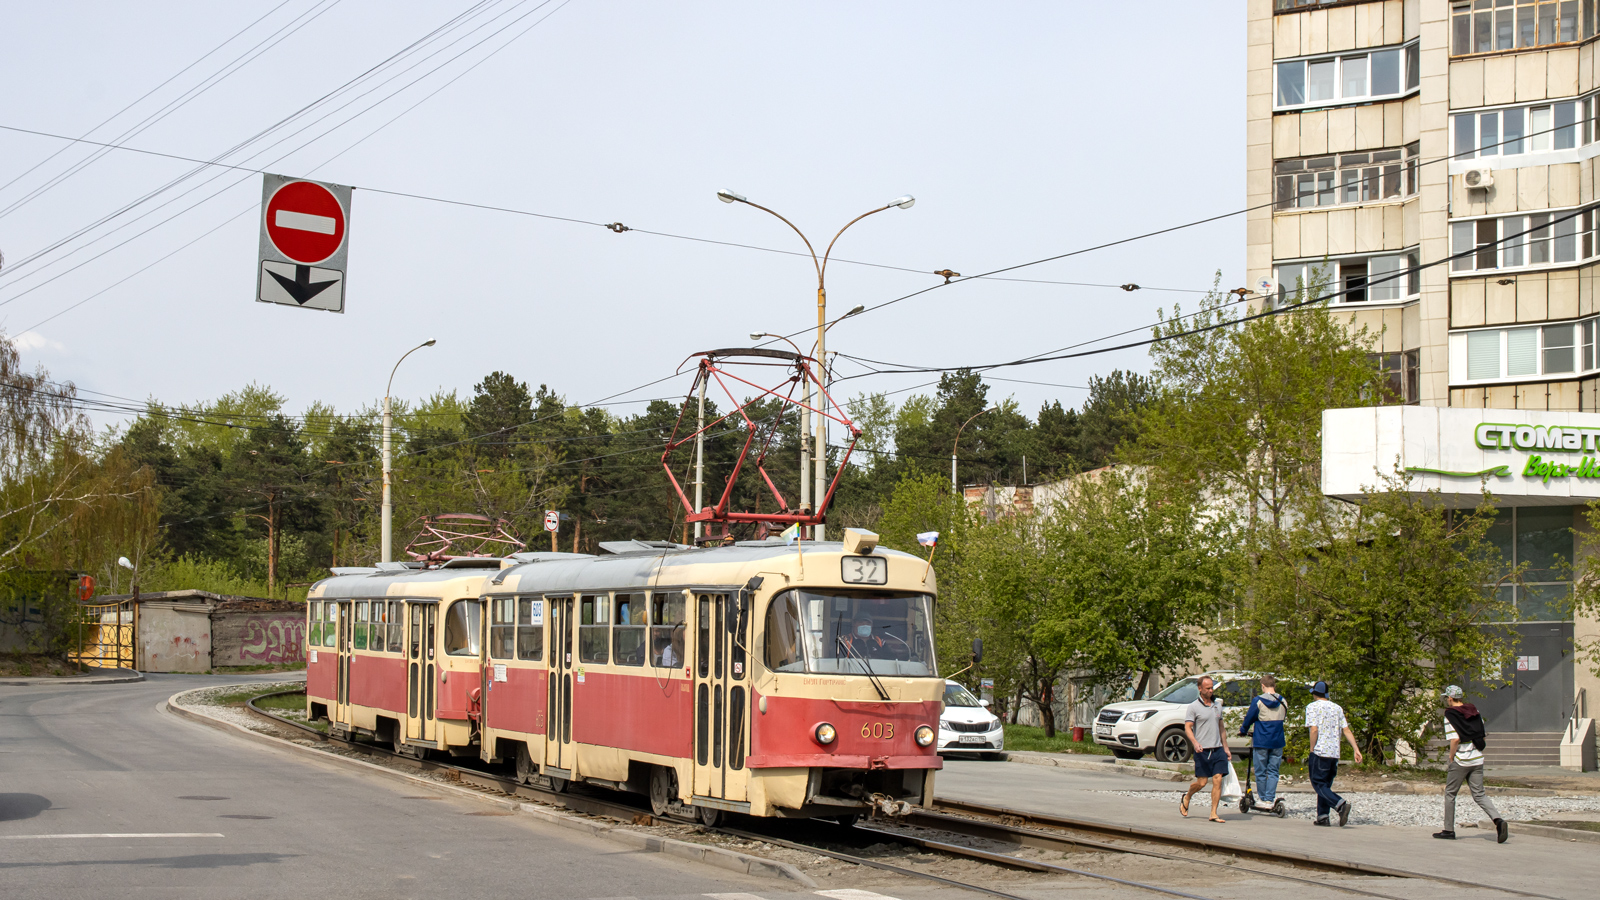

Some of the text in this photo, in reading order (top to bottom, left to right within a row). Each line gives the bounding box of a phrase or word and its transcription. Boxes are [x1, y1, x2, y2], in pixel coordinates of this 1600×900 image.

[852, 558, 878, 583] 32
[532, 602, 542, 617] 603
[861, 722, 894, 740] 603
